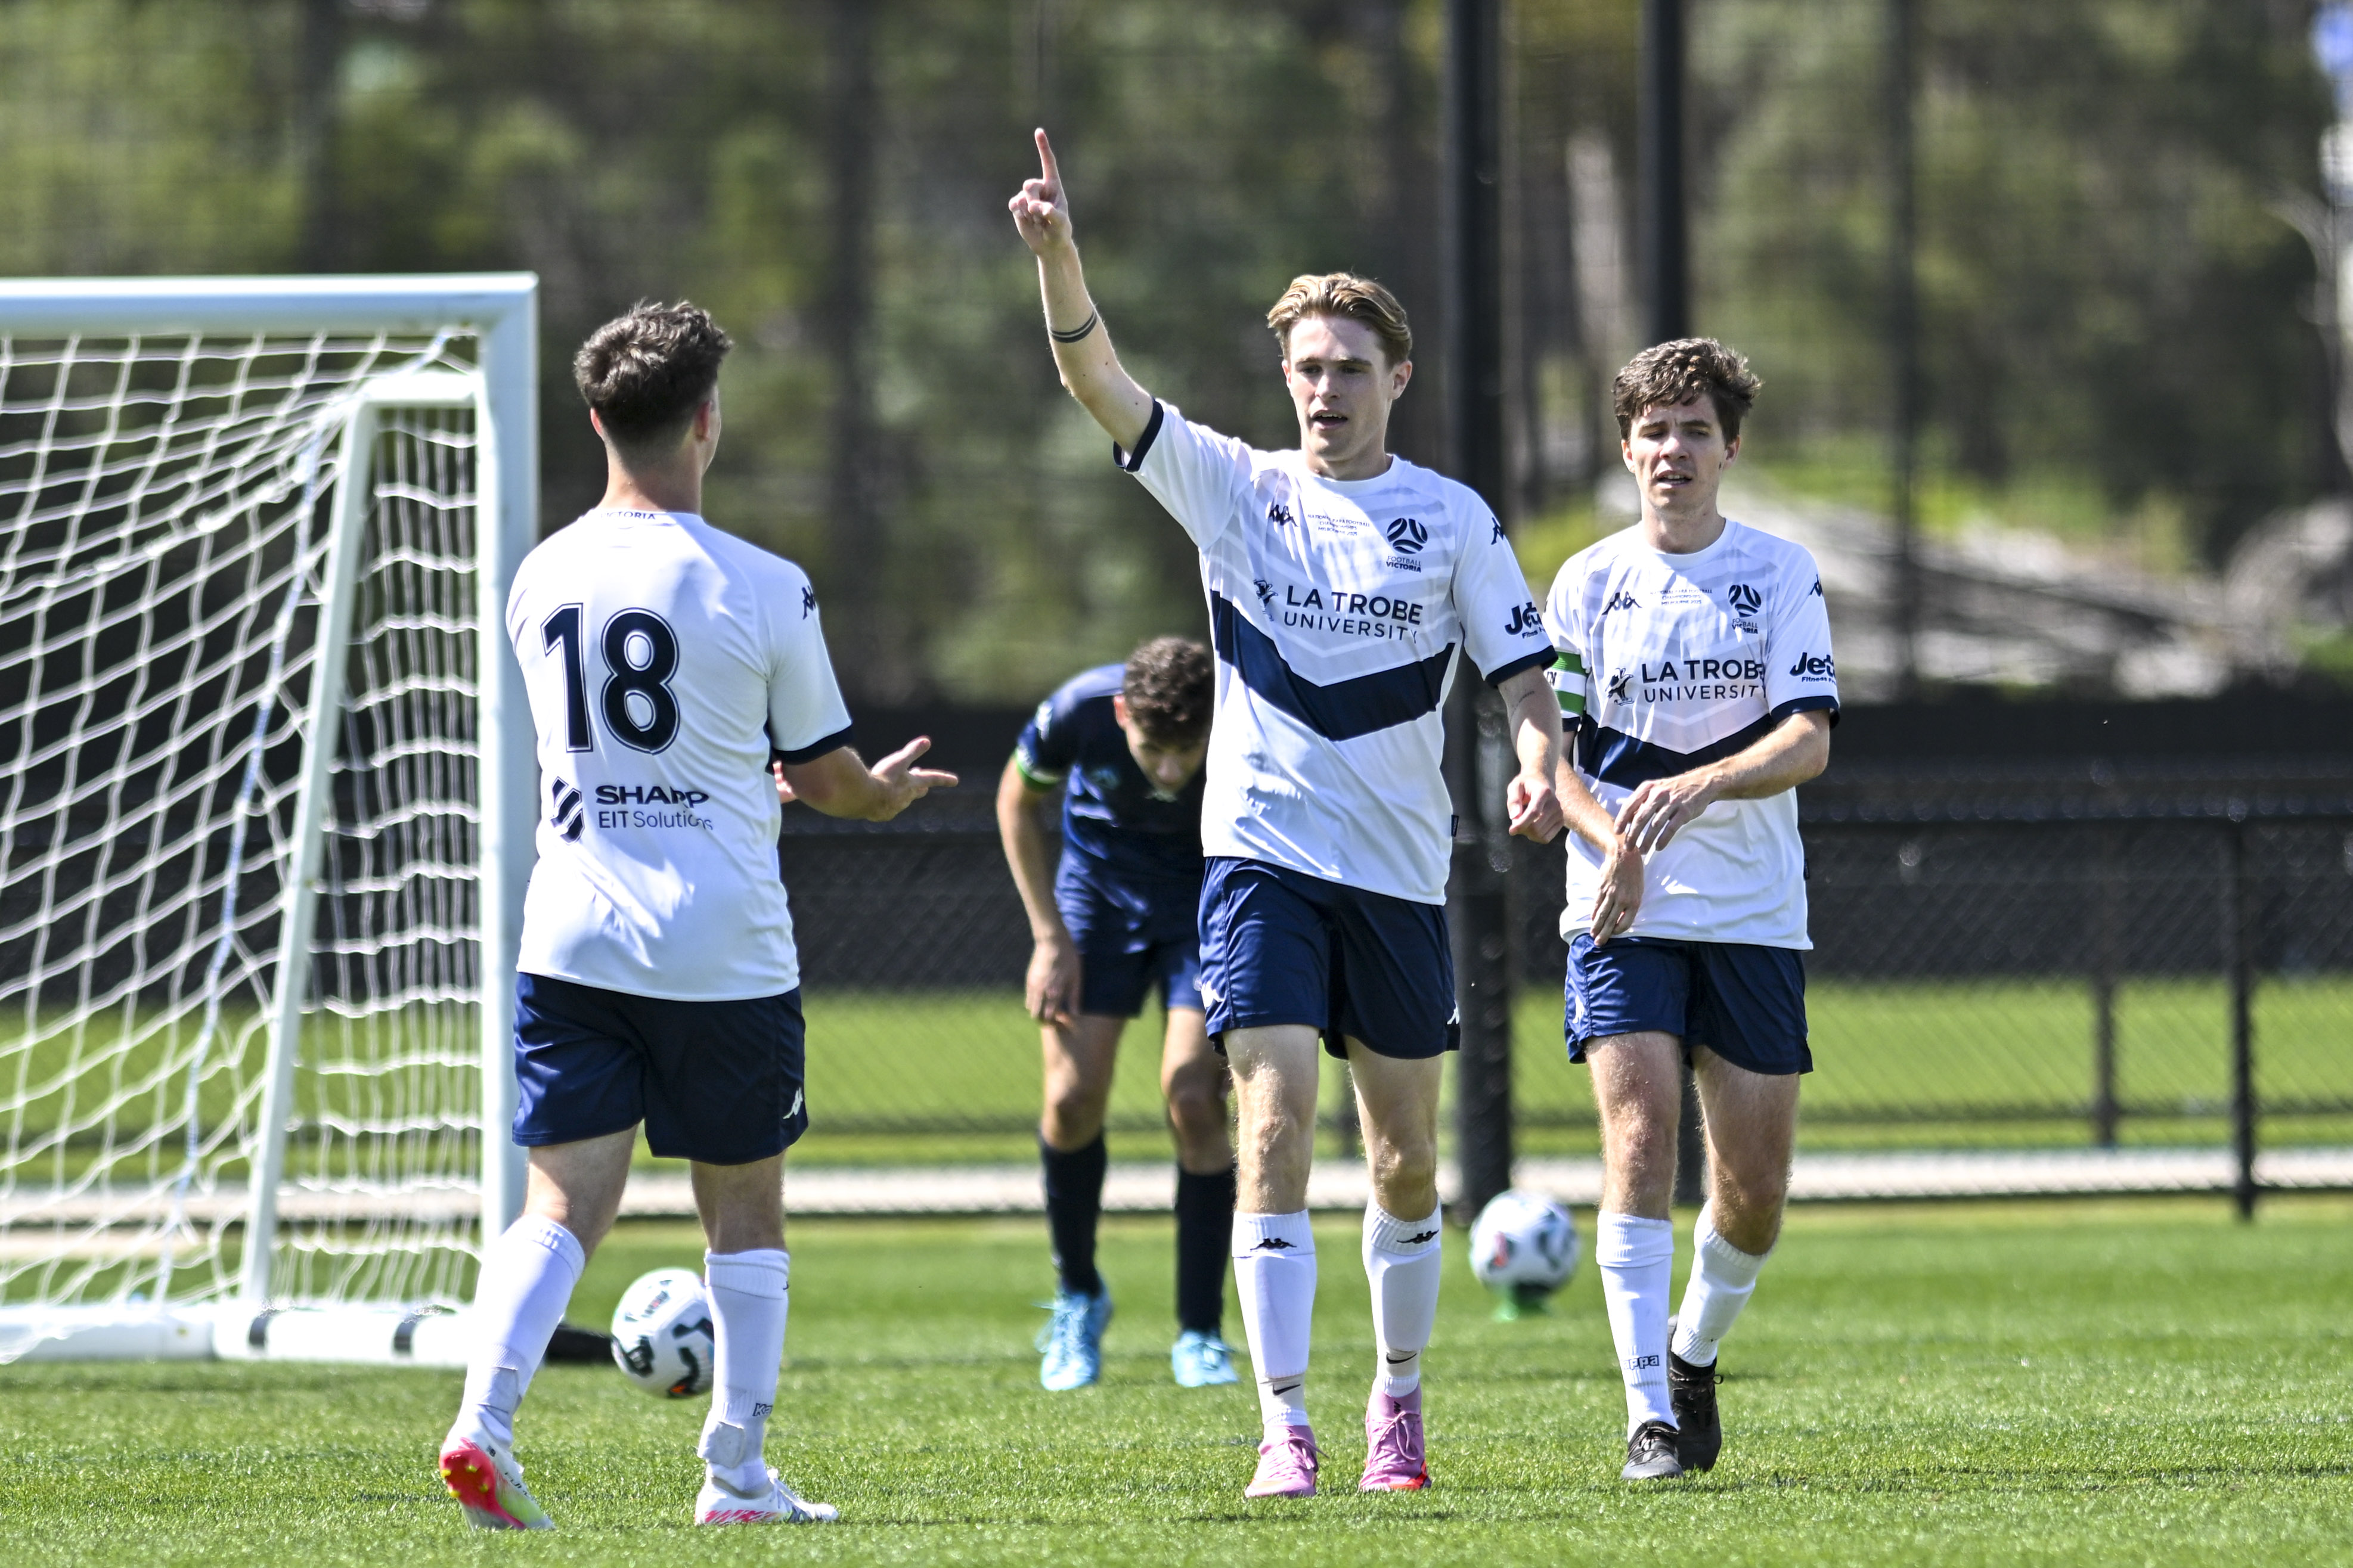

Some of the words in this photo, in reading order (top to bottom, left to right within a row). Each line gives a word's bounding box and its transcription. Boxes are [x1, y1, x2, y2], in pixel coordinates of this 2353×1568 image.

[601, 511, 656, 520] CTORIA
[1386, 561, 1421, 573] VICTORIA
[1387, 555, 1421, 567] FOOTBALL
[1286, 585, 1323, 610] LA
[1331, 592, 1423, 625] TROBE
[1284, 611, 1417, 644] UNIVERSITY
[540, 603, 680, 755] 18
[1642, 662, 1679, 684] LA
[1644, 685, 1766, 703] UNIVERSITY
[596, 785, 709, 809] SHARP
[599, 811, 628, 828] EIT
[1623, 1355, 1659, 1370] appa
